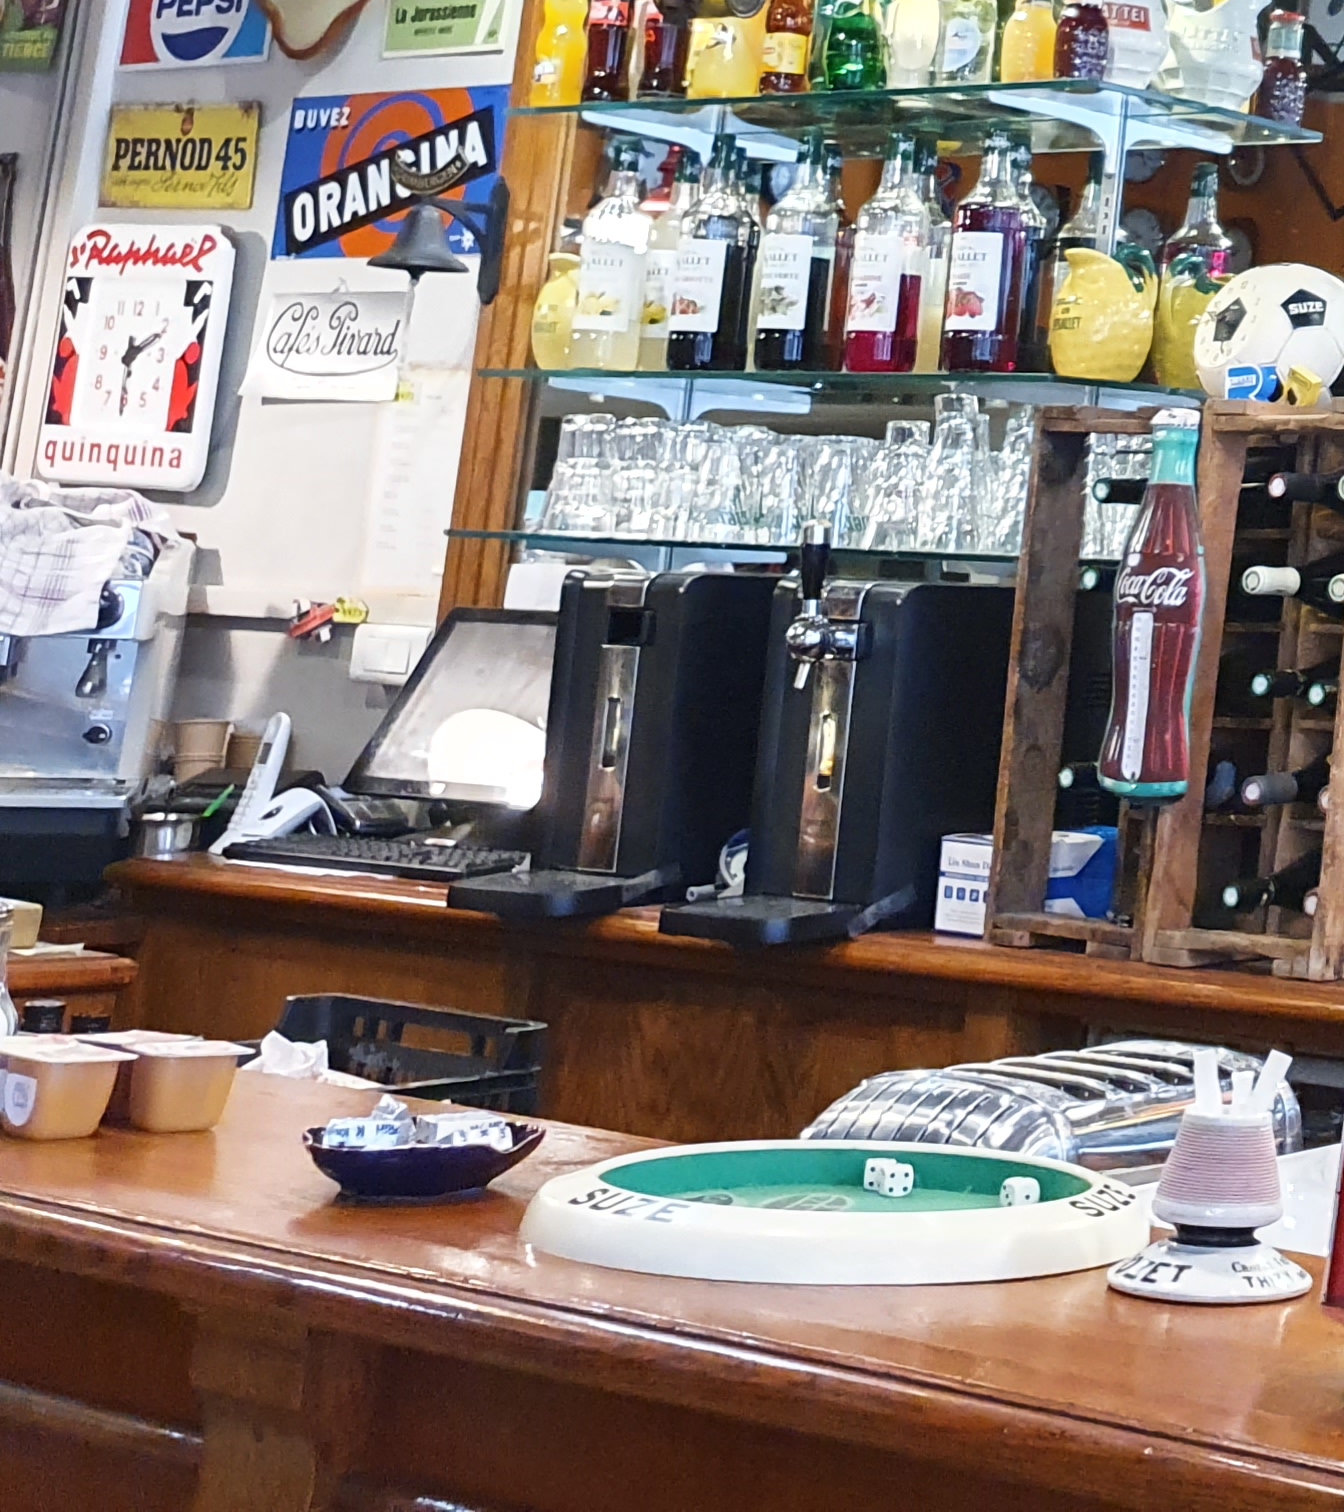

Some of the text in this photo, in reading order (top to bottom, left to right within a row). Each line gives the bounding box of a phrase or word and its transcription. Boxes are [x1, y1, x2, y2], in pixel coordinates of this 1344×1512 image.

[294, 106, 350, 130] BUVEZ
[112, 137, 249, 172] PERNOD 45
[86, 229, 217, 275] Raphaël
[1287, 299, 1325, 316] SUZE
[267, 301, 322, 368] Cafés
[45, 437, 182, 473] quinquina
[1116, 567, 1195, 607] Coca-Cola
[569, 1187, 692, 1224] SUZE
